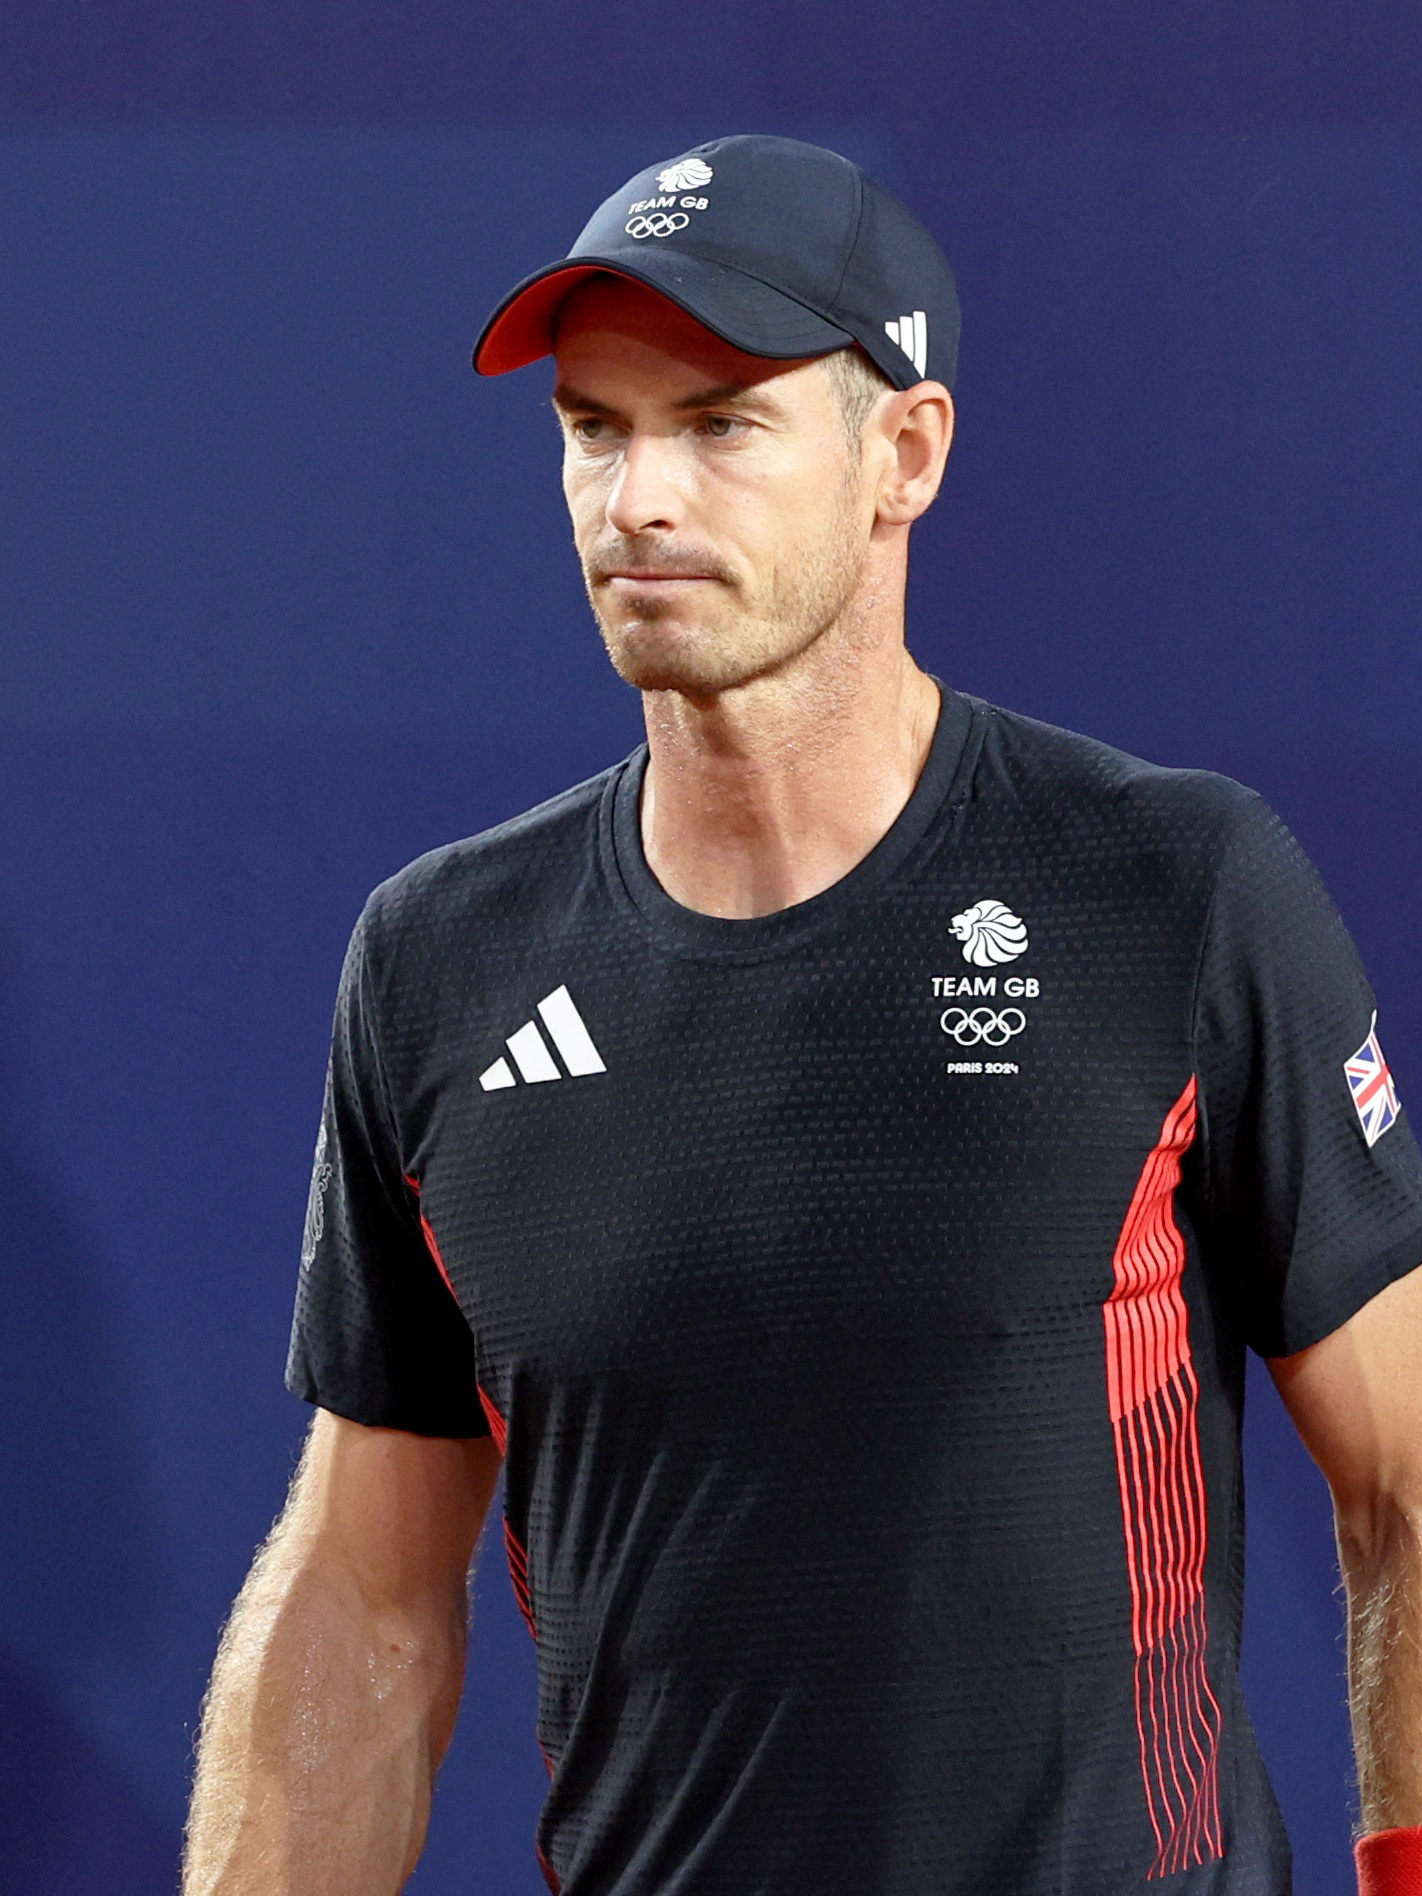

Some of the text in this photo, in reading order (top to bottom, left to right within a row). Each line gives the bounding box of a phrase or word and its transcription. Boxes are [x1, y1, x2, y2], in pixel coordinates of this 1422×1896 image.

[628, 196, 709, 214] TEAM GB
[931, 977, 1040, 998] TEAM GB
[947, 1063, 1019, 1074] PARIS 2024
